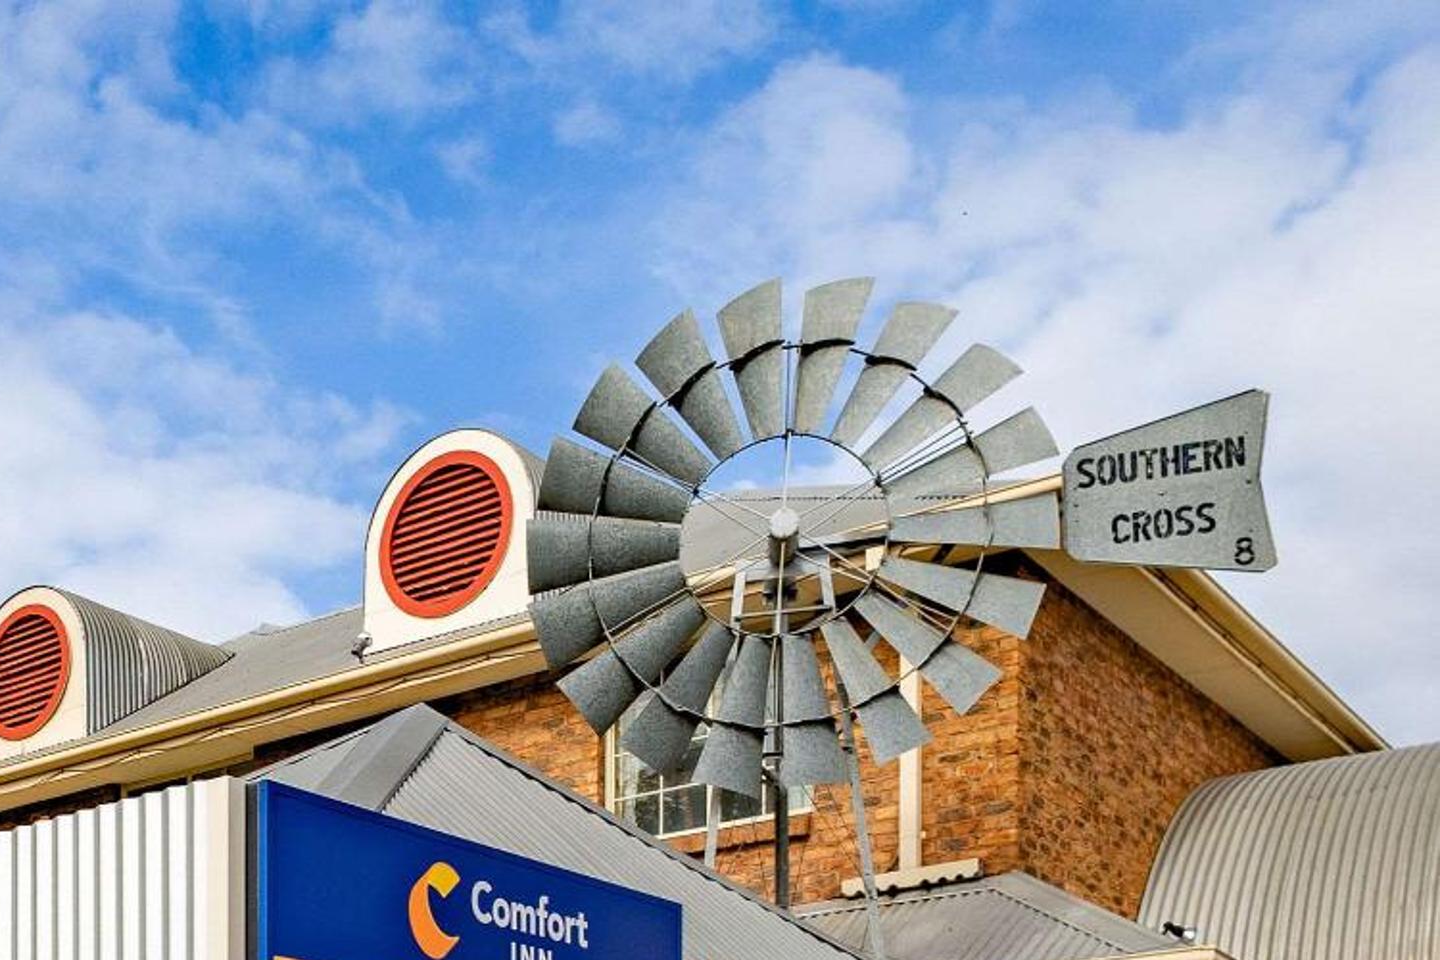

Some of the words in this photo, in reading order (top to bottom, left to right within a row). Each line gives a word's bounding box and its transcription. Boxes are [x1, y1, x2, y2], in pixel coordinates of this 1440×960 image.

[1076, 436, 1245, 488] SOUTHERN
[1111, 503, 1216, 544] CROSS
[1234, 537, 1255, 565] 8
[470, 880, 589, 949] Comfort
